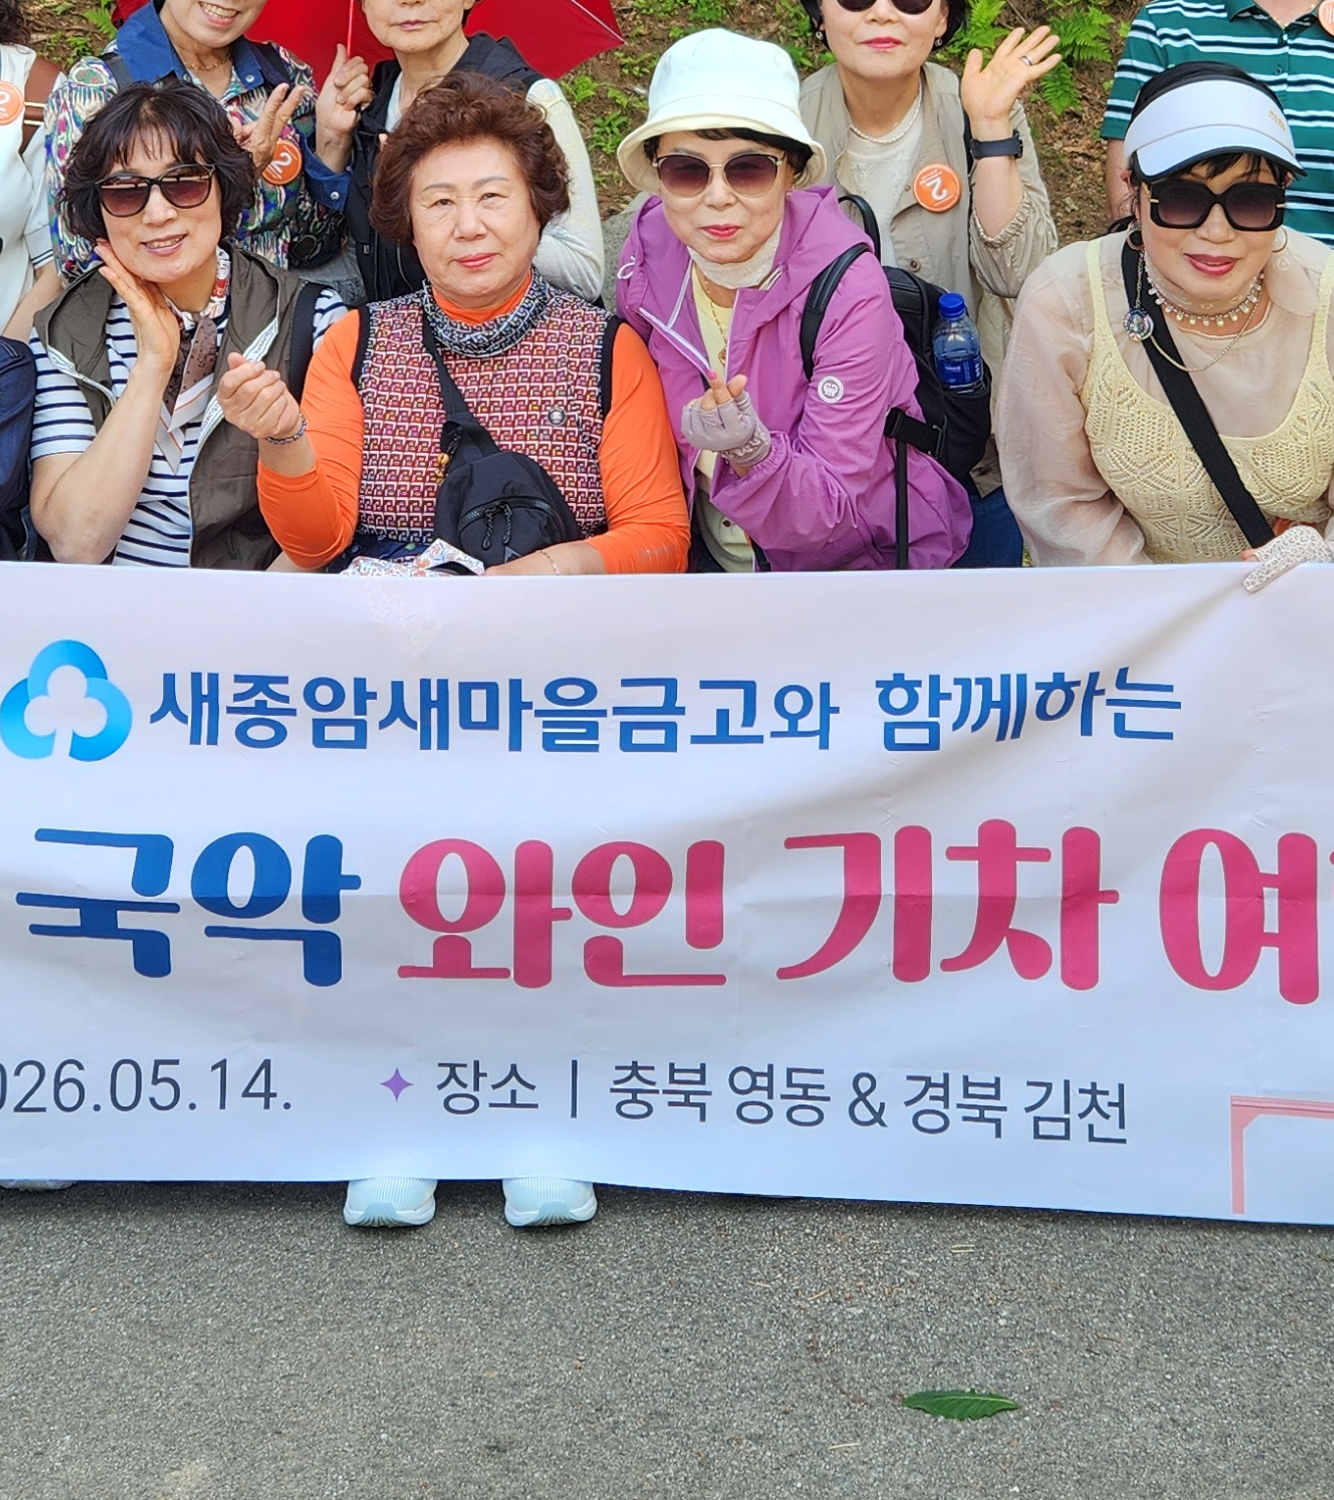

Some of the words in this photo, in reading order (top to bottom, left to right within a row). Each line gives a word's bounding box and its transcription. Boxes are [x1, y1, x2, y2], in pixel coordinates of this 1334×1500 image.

[270, 152, 292, 174] 2
[926, 176, 947, 200] 2
[149, 671, 840, 753] 새종암새마을금고와
[875, 667, 1183, 752] 함께하는
[15, 827, 363, 987] 국악
[398, 838, 726, 988] 와인
[777, 819, 1119, 991] 기차
[436, 1059, 539, 1116] 장소
[609, 1060, 713, 1123] 충북
[728, 1063, 831, 1127] 영동
[848, 1071, 888, 1128] &
[903, 1073, 1008, 1139] 경북
[1023, 1079, 1128, 1145] 김천
